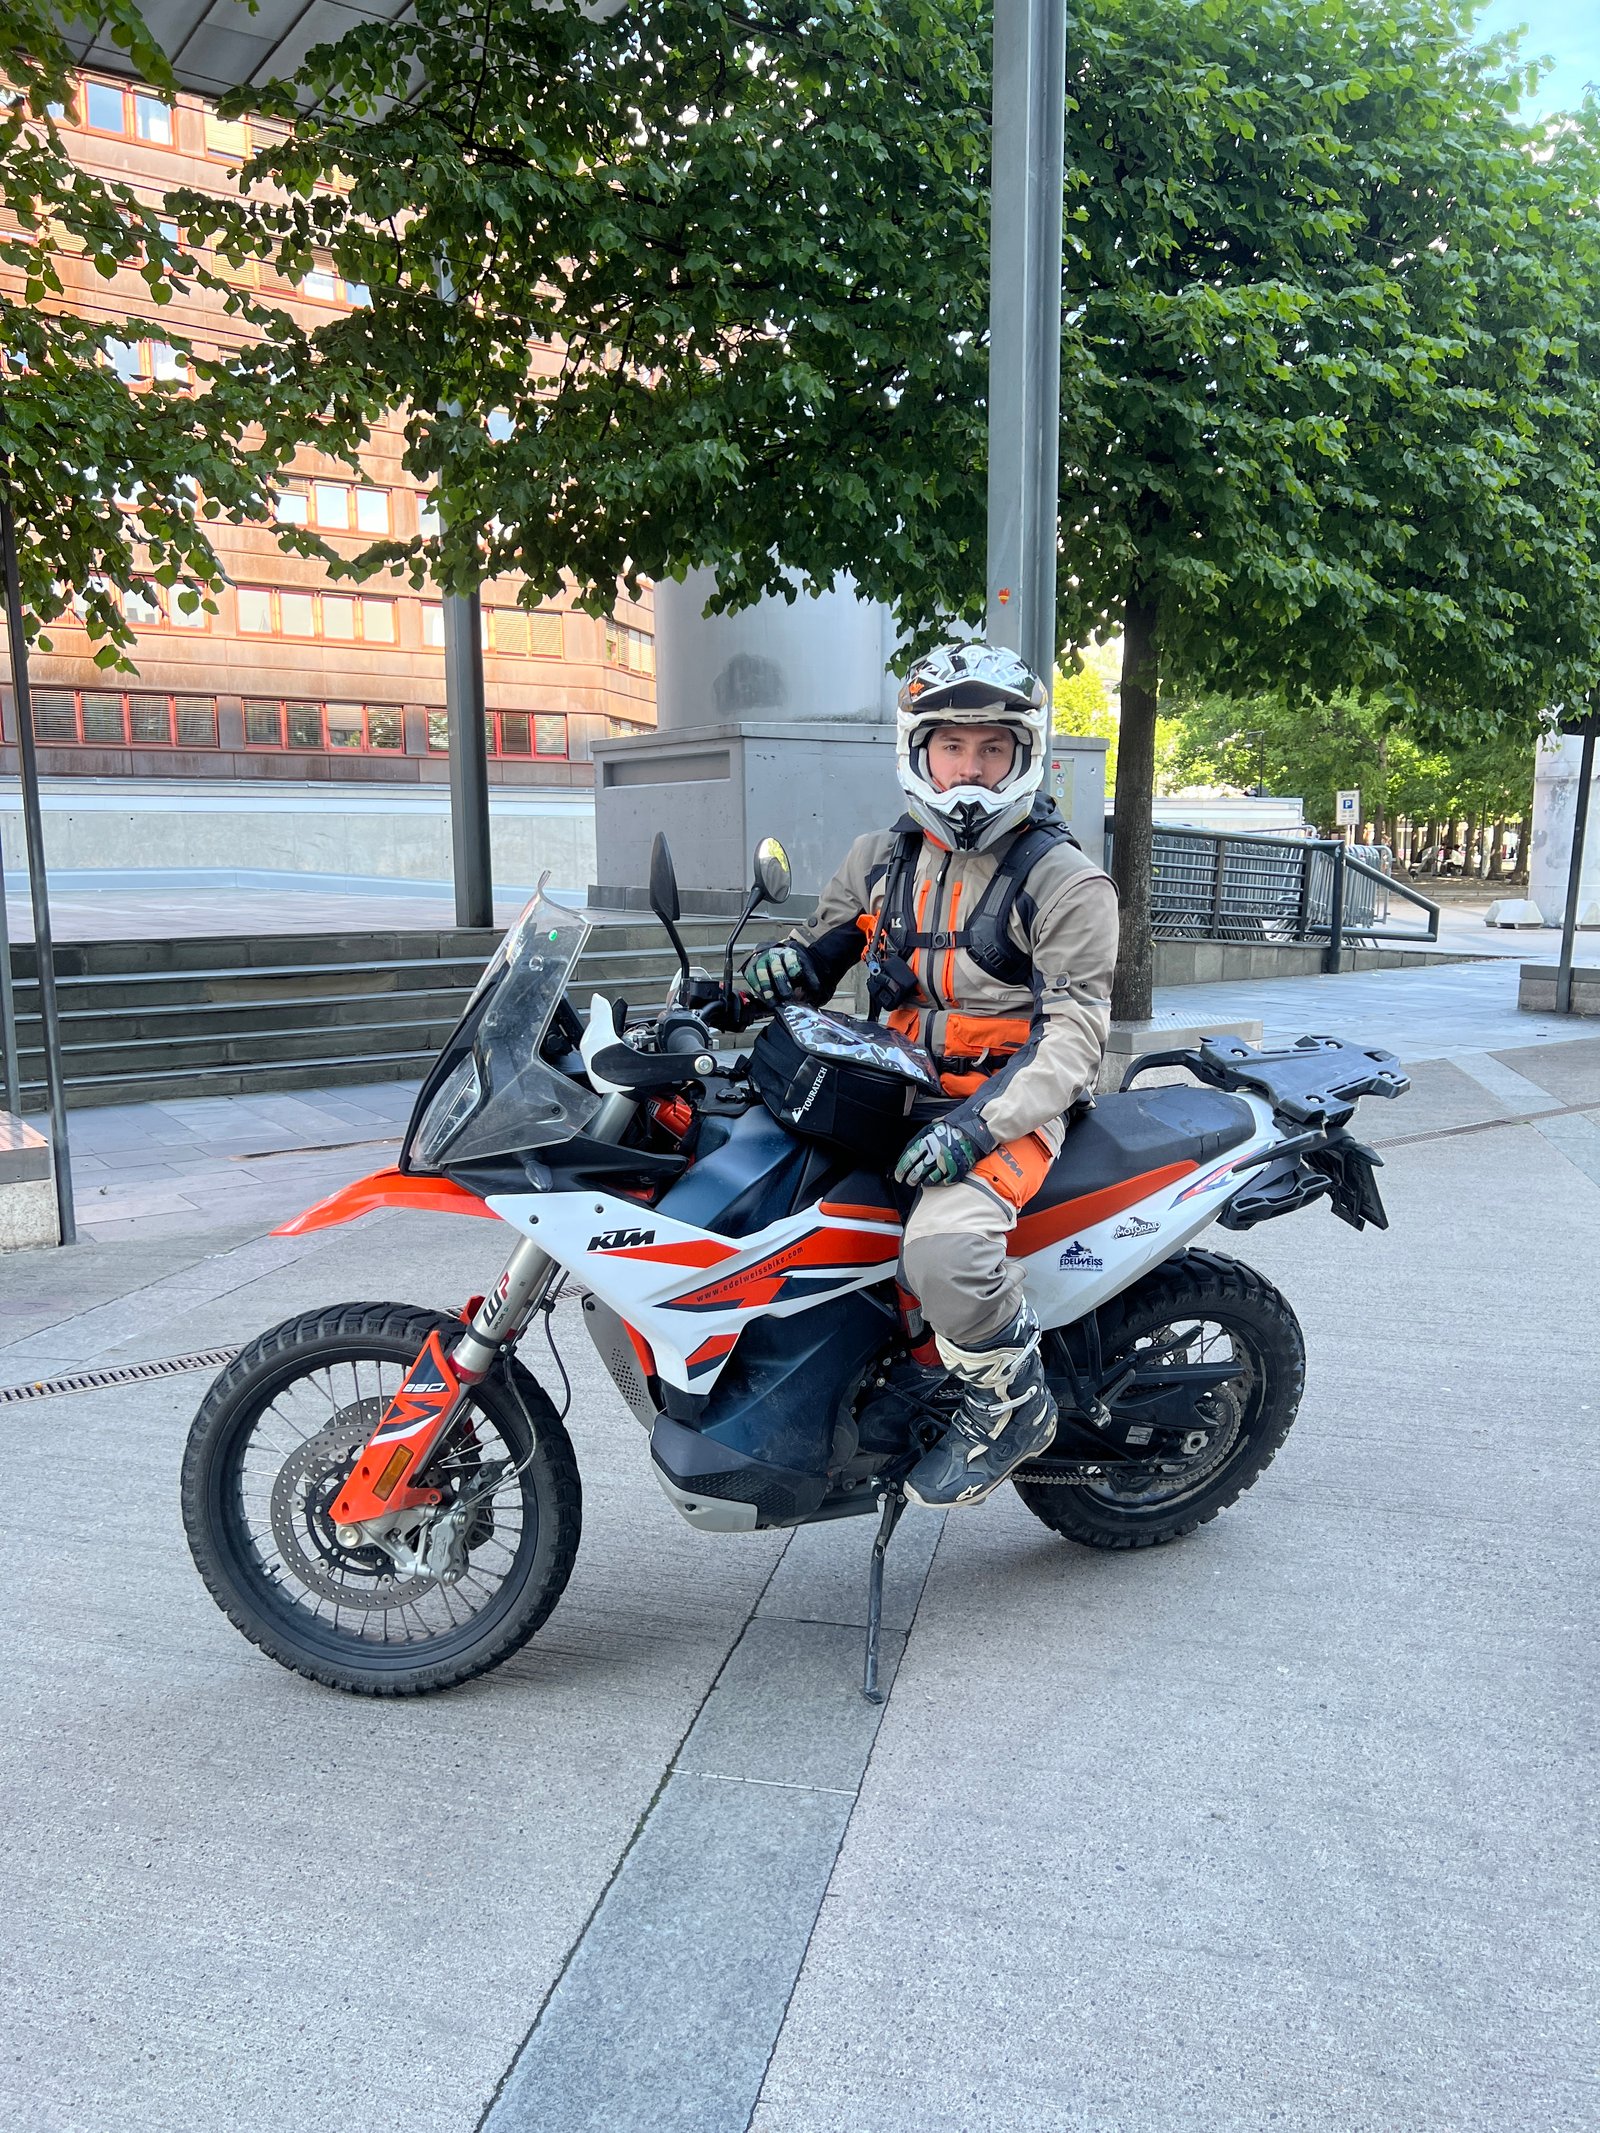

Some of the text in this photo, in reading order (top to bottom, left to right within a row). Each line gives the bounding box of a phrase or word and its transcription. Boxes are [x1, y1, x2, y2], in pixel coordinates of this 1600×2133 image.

[803, 1066, 828, 1112] TOURATECH
[996, 1145, 1024, 1178] KTM
[586, 1227, 656, 1251] KTM
[1116, 1221, 1160, 1238] MOTORAID
[696, 1246, 804, 1303] www.edelweissbike.com
[1059, 1257, 1103, 1266] EDELWEISS
[483, 1271, 510, 1327] WP
